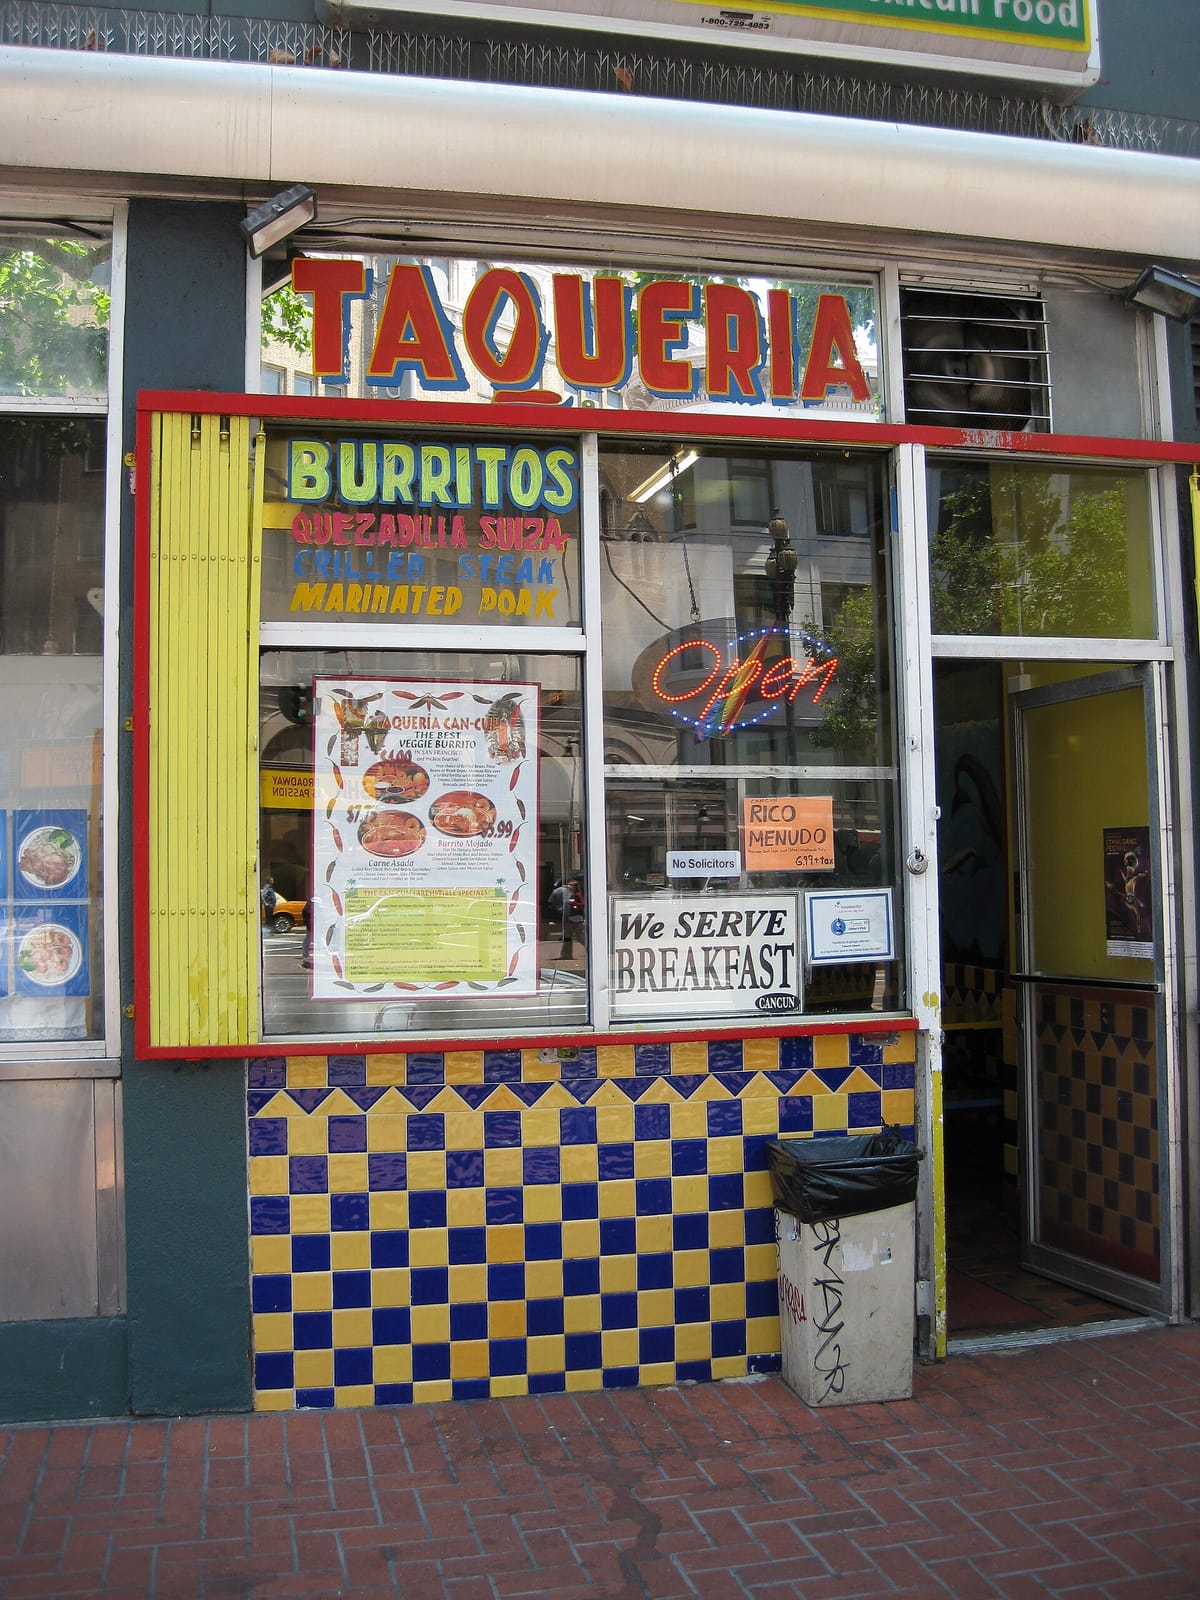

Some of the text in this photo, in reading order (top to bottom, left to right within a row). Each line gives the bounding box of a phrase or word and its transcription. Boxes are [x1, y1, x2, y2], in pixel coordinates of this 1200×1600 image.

[292, 256, 872, 406] TAQUERIA
[288, 438, 579, 513] BURRITOS
[291, 511, 571, 553] QUEZADILLA SUIZA
[458, 553, 556, 585] STEAK
[289, 582, 560, 618] MARINATED PORK
[652, 640, 839, 719] Open
[399, 739, 477, 749] VEGGIE BURRITO
[415, 731, 462, 740] THE BEST
[749, 804, 797, 823] RICO
[748, 828, 827, 847] MENUDO
[672, 858, 735, 869] No Solicitors
[619, 909, 789, 941] We SERVE
[614, 942, 796, 994] BREAKFAST
[758, 995, 795, 1010] CANCUN
